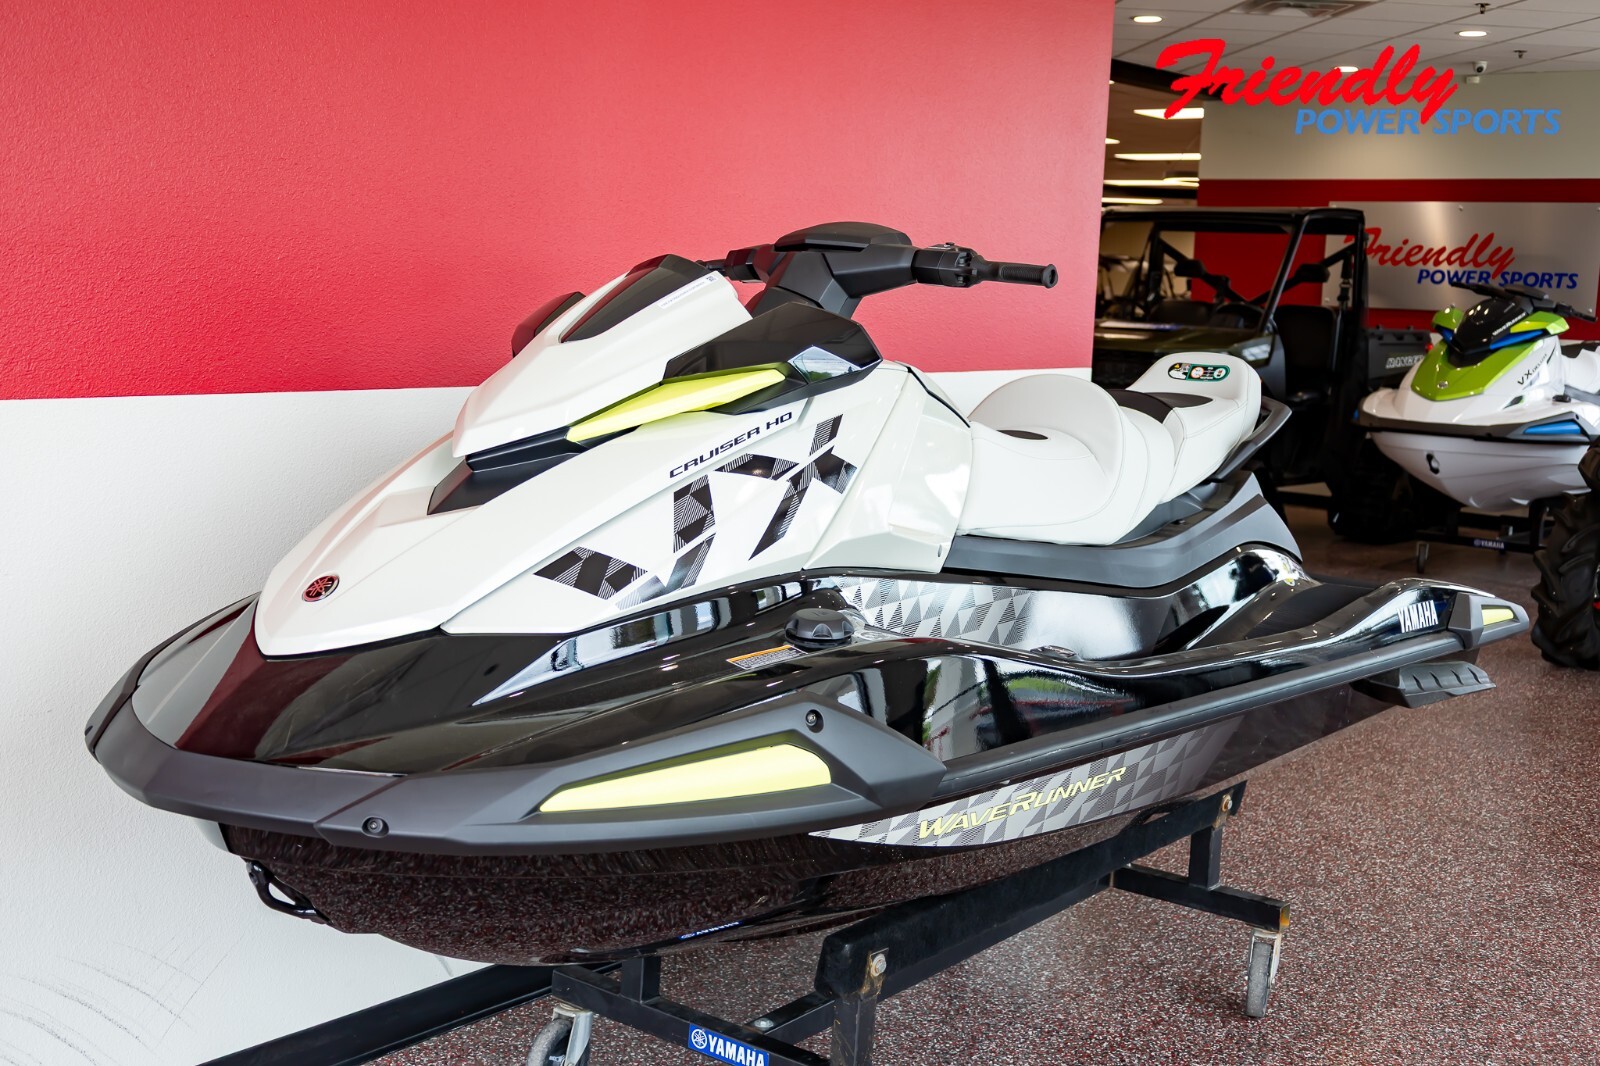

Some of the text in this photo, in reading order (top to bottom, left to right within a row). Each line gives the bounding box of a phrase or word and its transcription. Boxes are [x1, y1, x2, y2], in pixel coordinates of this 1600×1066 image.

[1417, 269, 1579, 289] POWER SPORTS
[669, 426, 761, 479] CRUISER
[1397, 599, 1439, 634] YAMAHA
[919, 766, 1128, 839] WAVERUNNER
[708, 1034, 765, 1066] YAMAHA
